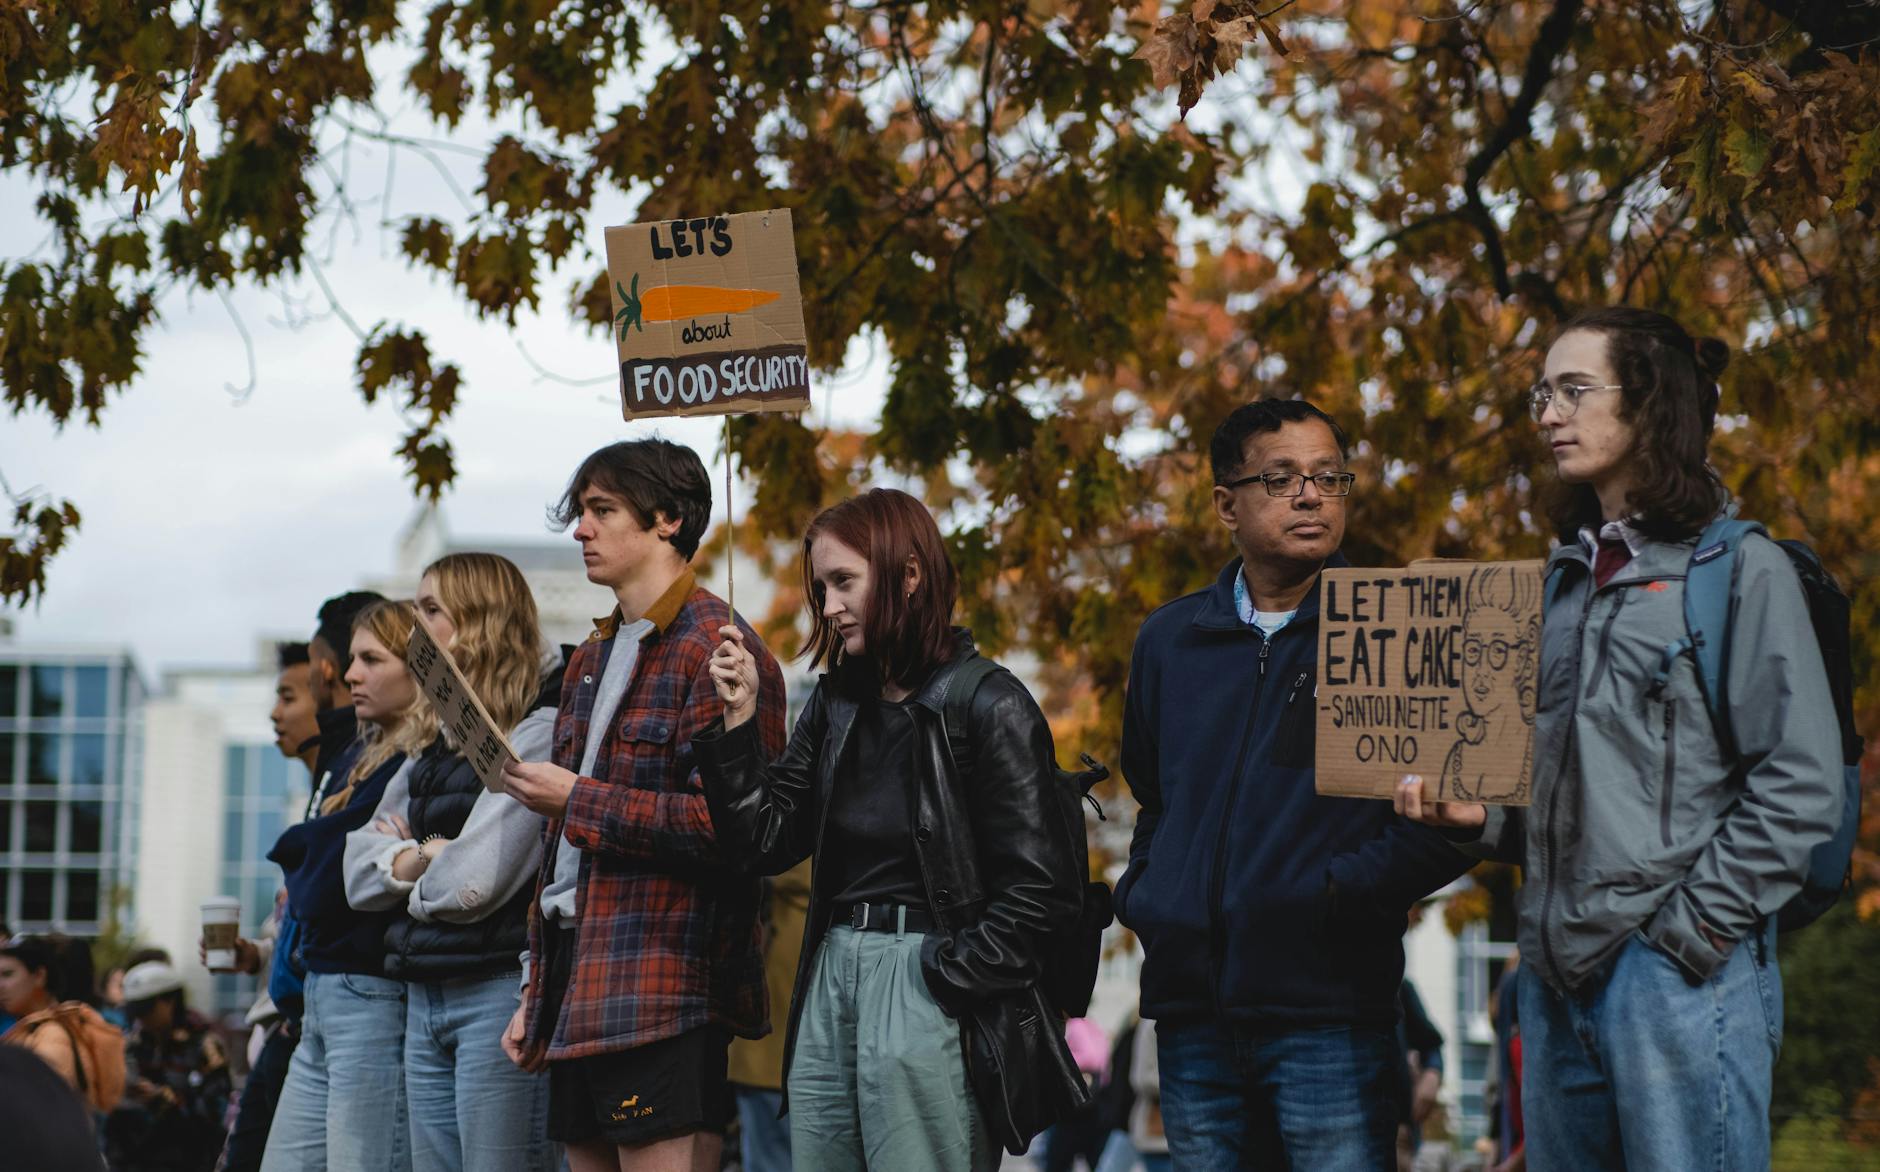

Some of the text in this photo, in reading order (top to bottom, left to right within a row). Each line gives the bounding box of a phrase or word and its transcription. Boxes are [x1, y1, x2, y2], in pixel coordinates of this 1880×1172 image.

[651, 216, 733, 260] LET'S
[682, 315, 732, 344] about
[633, 354, 808, 404] FOOD SECURITY
[1326, 575, 1462, 622] LET THEM
[1326, 625, 1462, 689] EAT CAKE
[1356, 734, 1418, 764] ONO
